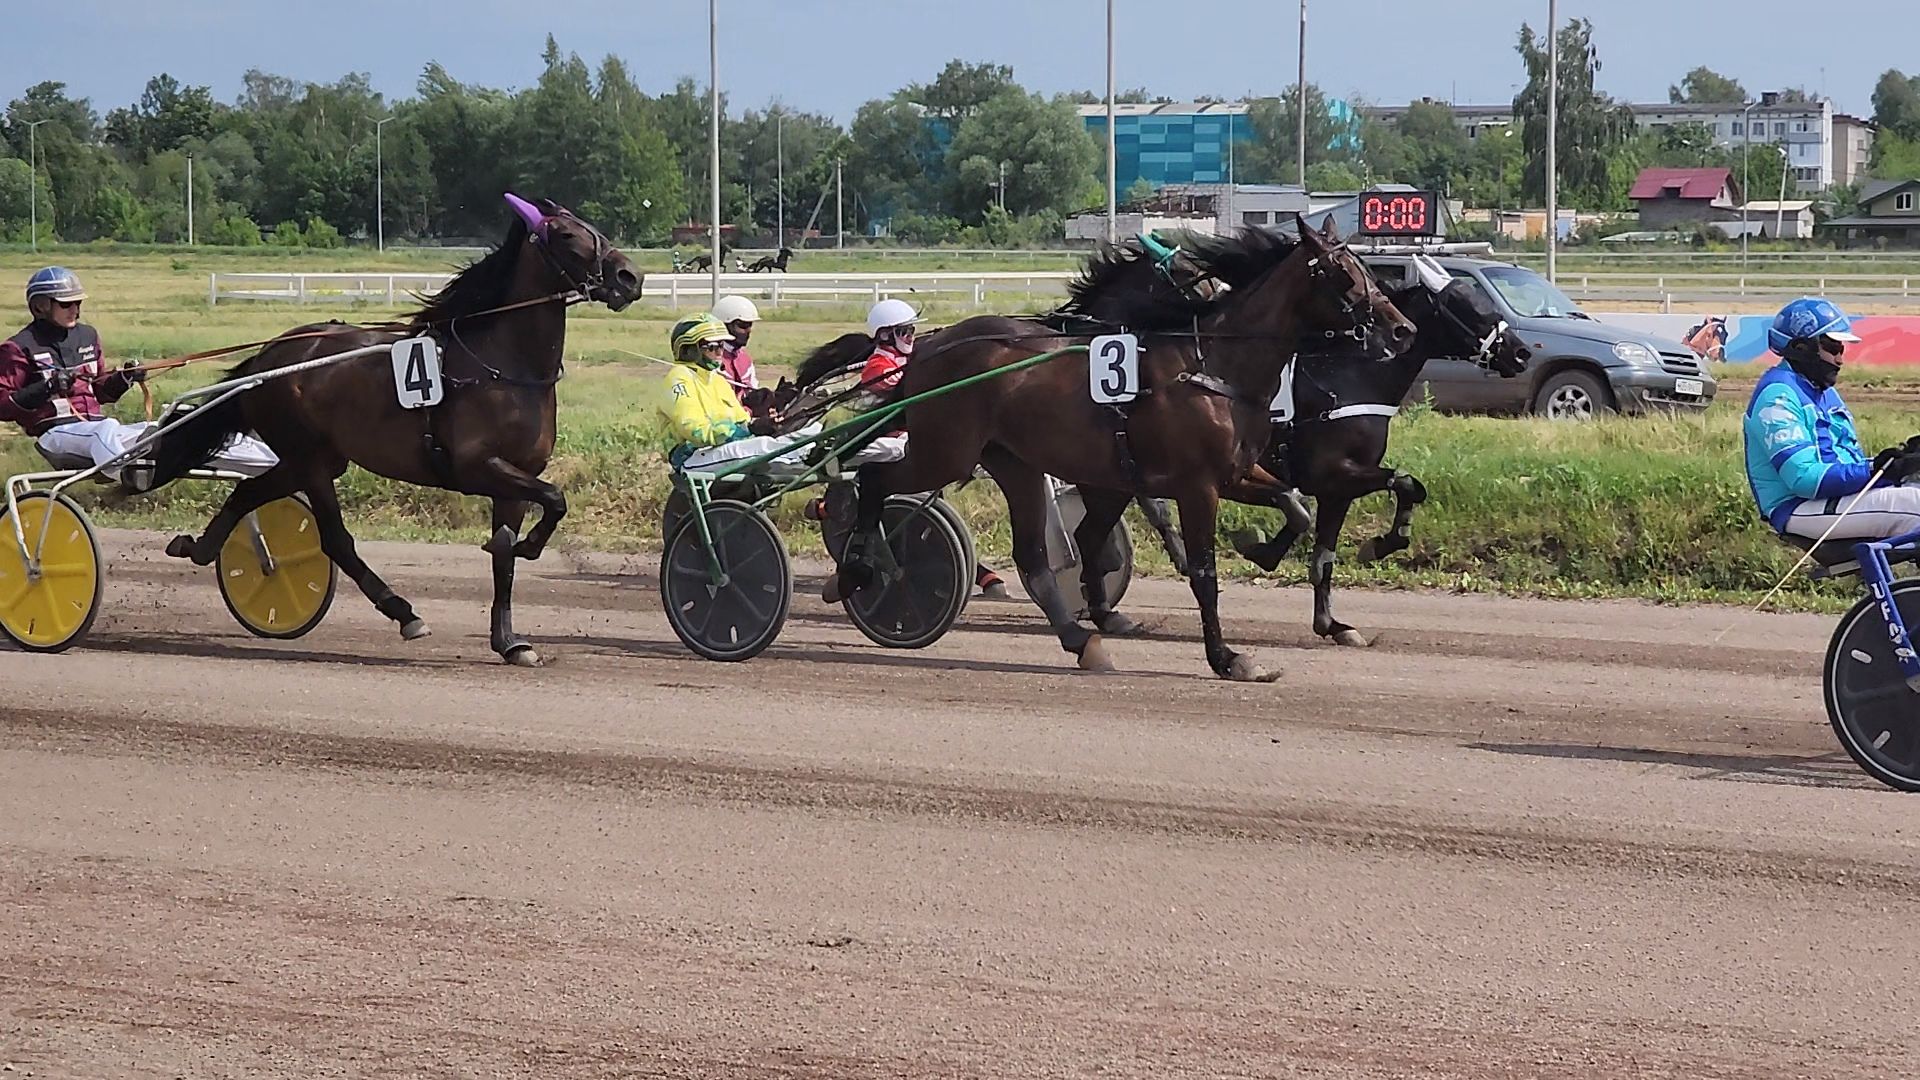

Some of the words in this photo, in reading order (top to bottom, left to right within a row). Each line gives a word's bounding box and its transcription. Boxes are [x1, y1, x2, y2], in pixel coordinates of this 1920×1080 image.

[1364, 197, 1425, 229] 0:00
[404, 342, 433, 402] 4
[1100, 340, 1126, 397] 3
